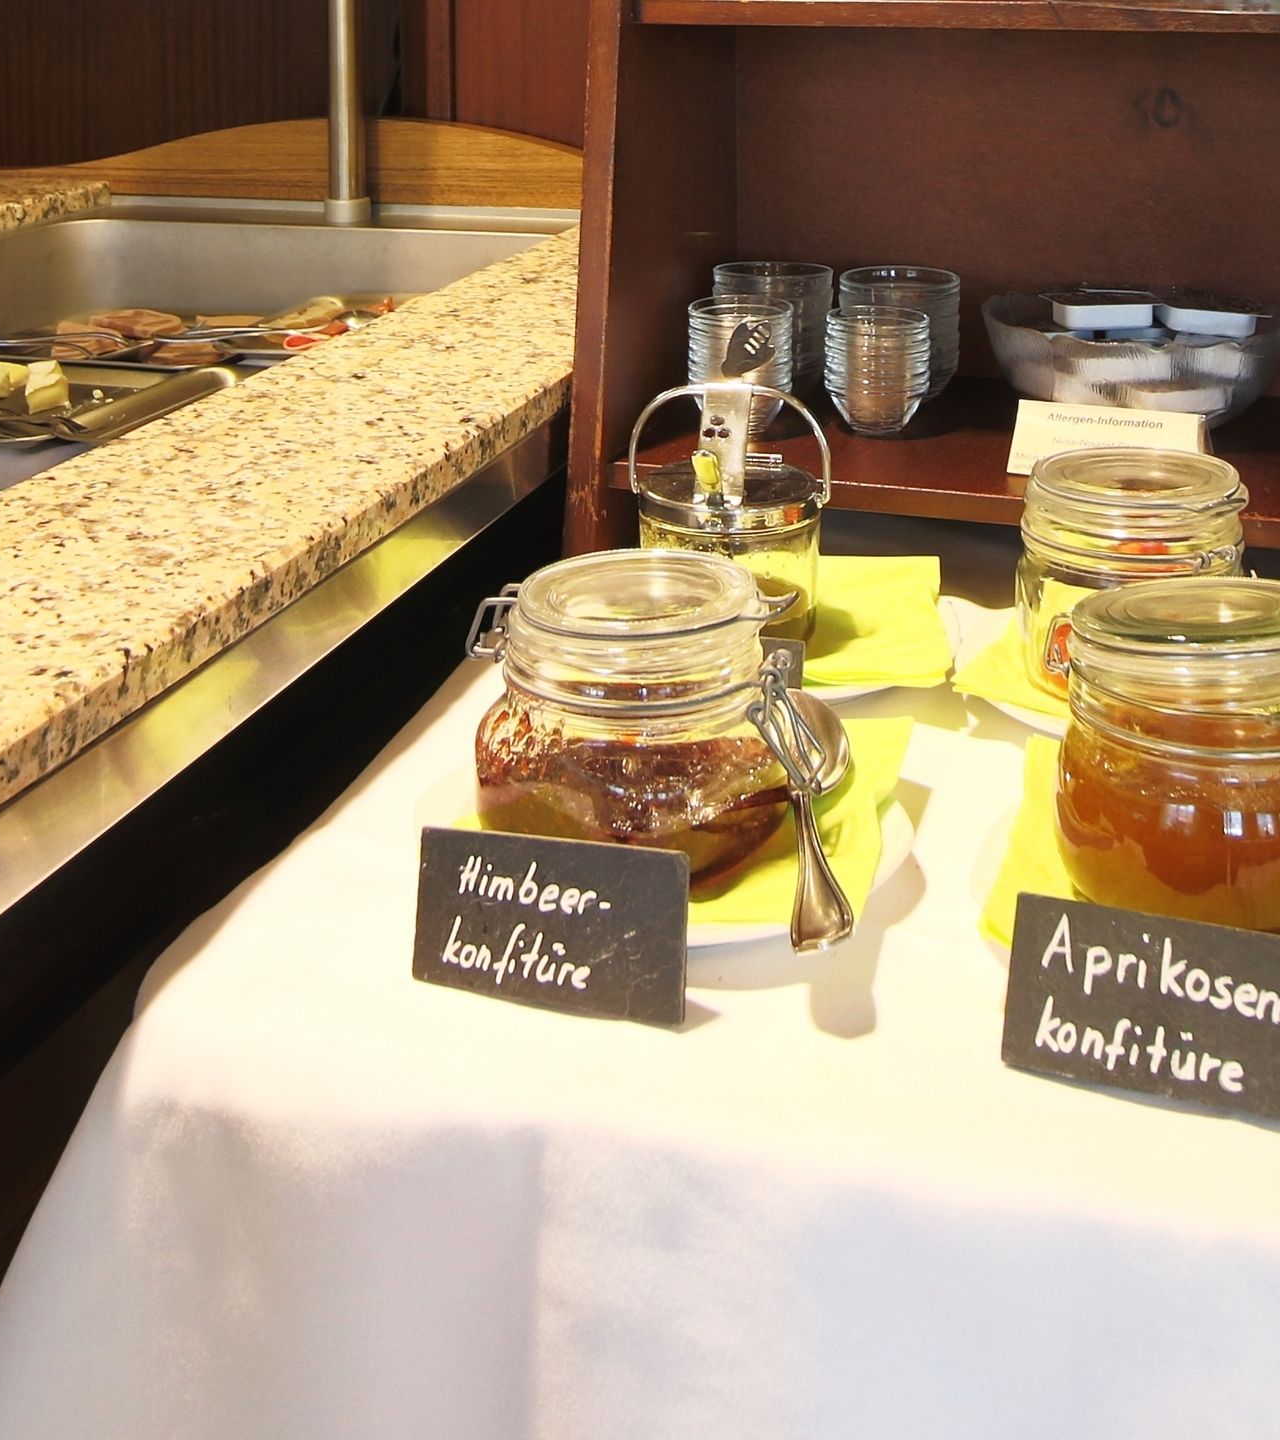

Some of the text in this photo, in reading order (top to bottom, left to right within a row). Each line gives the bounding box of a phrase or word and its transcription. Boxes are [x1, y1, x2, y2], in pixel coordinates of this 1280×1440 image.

[1046, 412, 1164, 431] Allergen-Information
[458, 855, 612, 915] Himbeer-
[441, 915, 592, 990] konfitüre
[1035, 995, 1245, 1093] konfitüre
